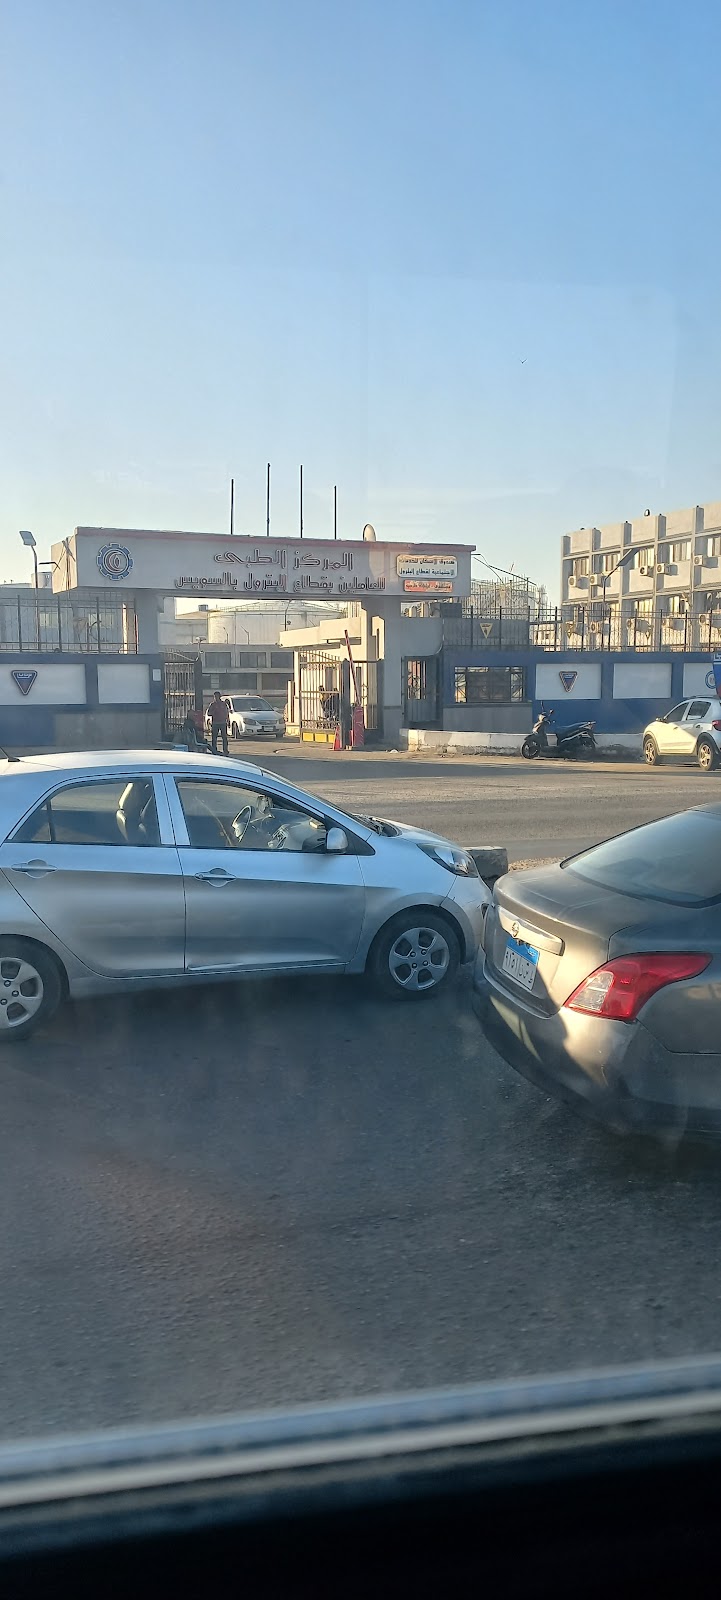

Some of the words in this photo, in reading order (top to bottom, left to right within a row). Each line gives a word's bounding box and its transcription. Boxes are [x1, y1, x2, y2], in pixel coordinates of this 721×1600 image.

[293, 550, 353, 571] المركز
[174, 571, 238, 590] بالسويس
[244, 572, 288, 592] البترول
[293, 575, 334, 593] بقطاع
[338, 576, 386, 593] للعاملين
